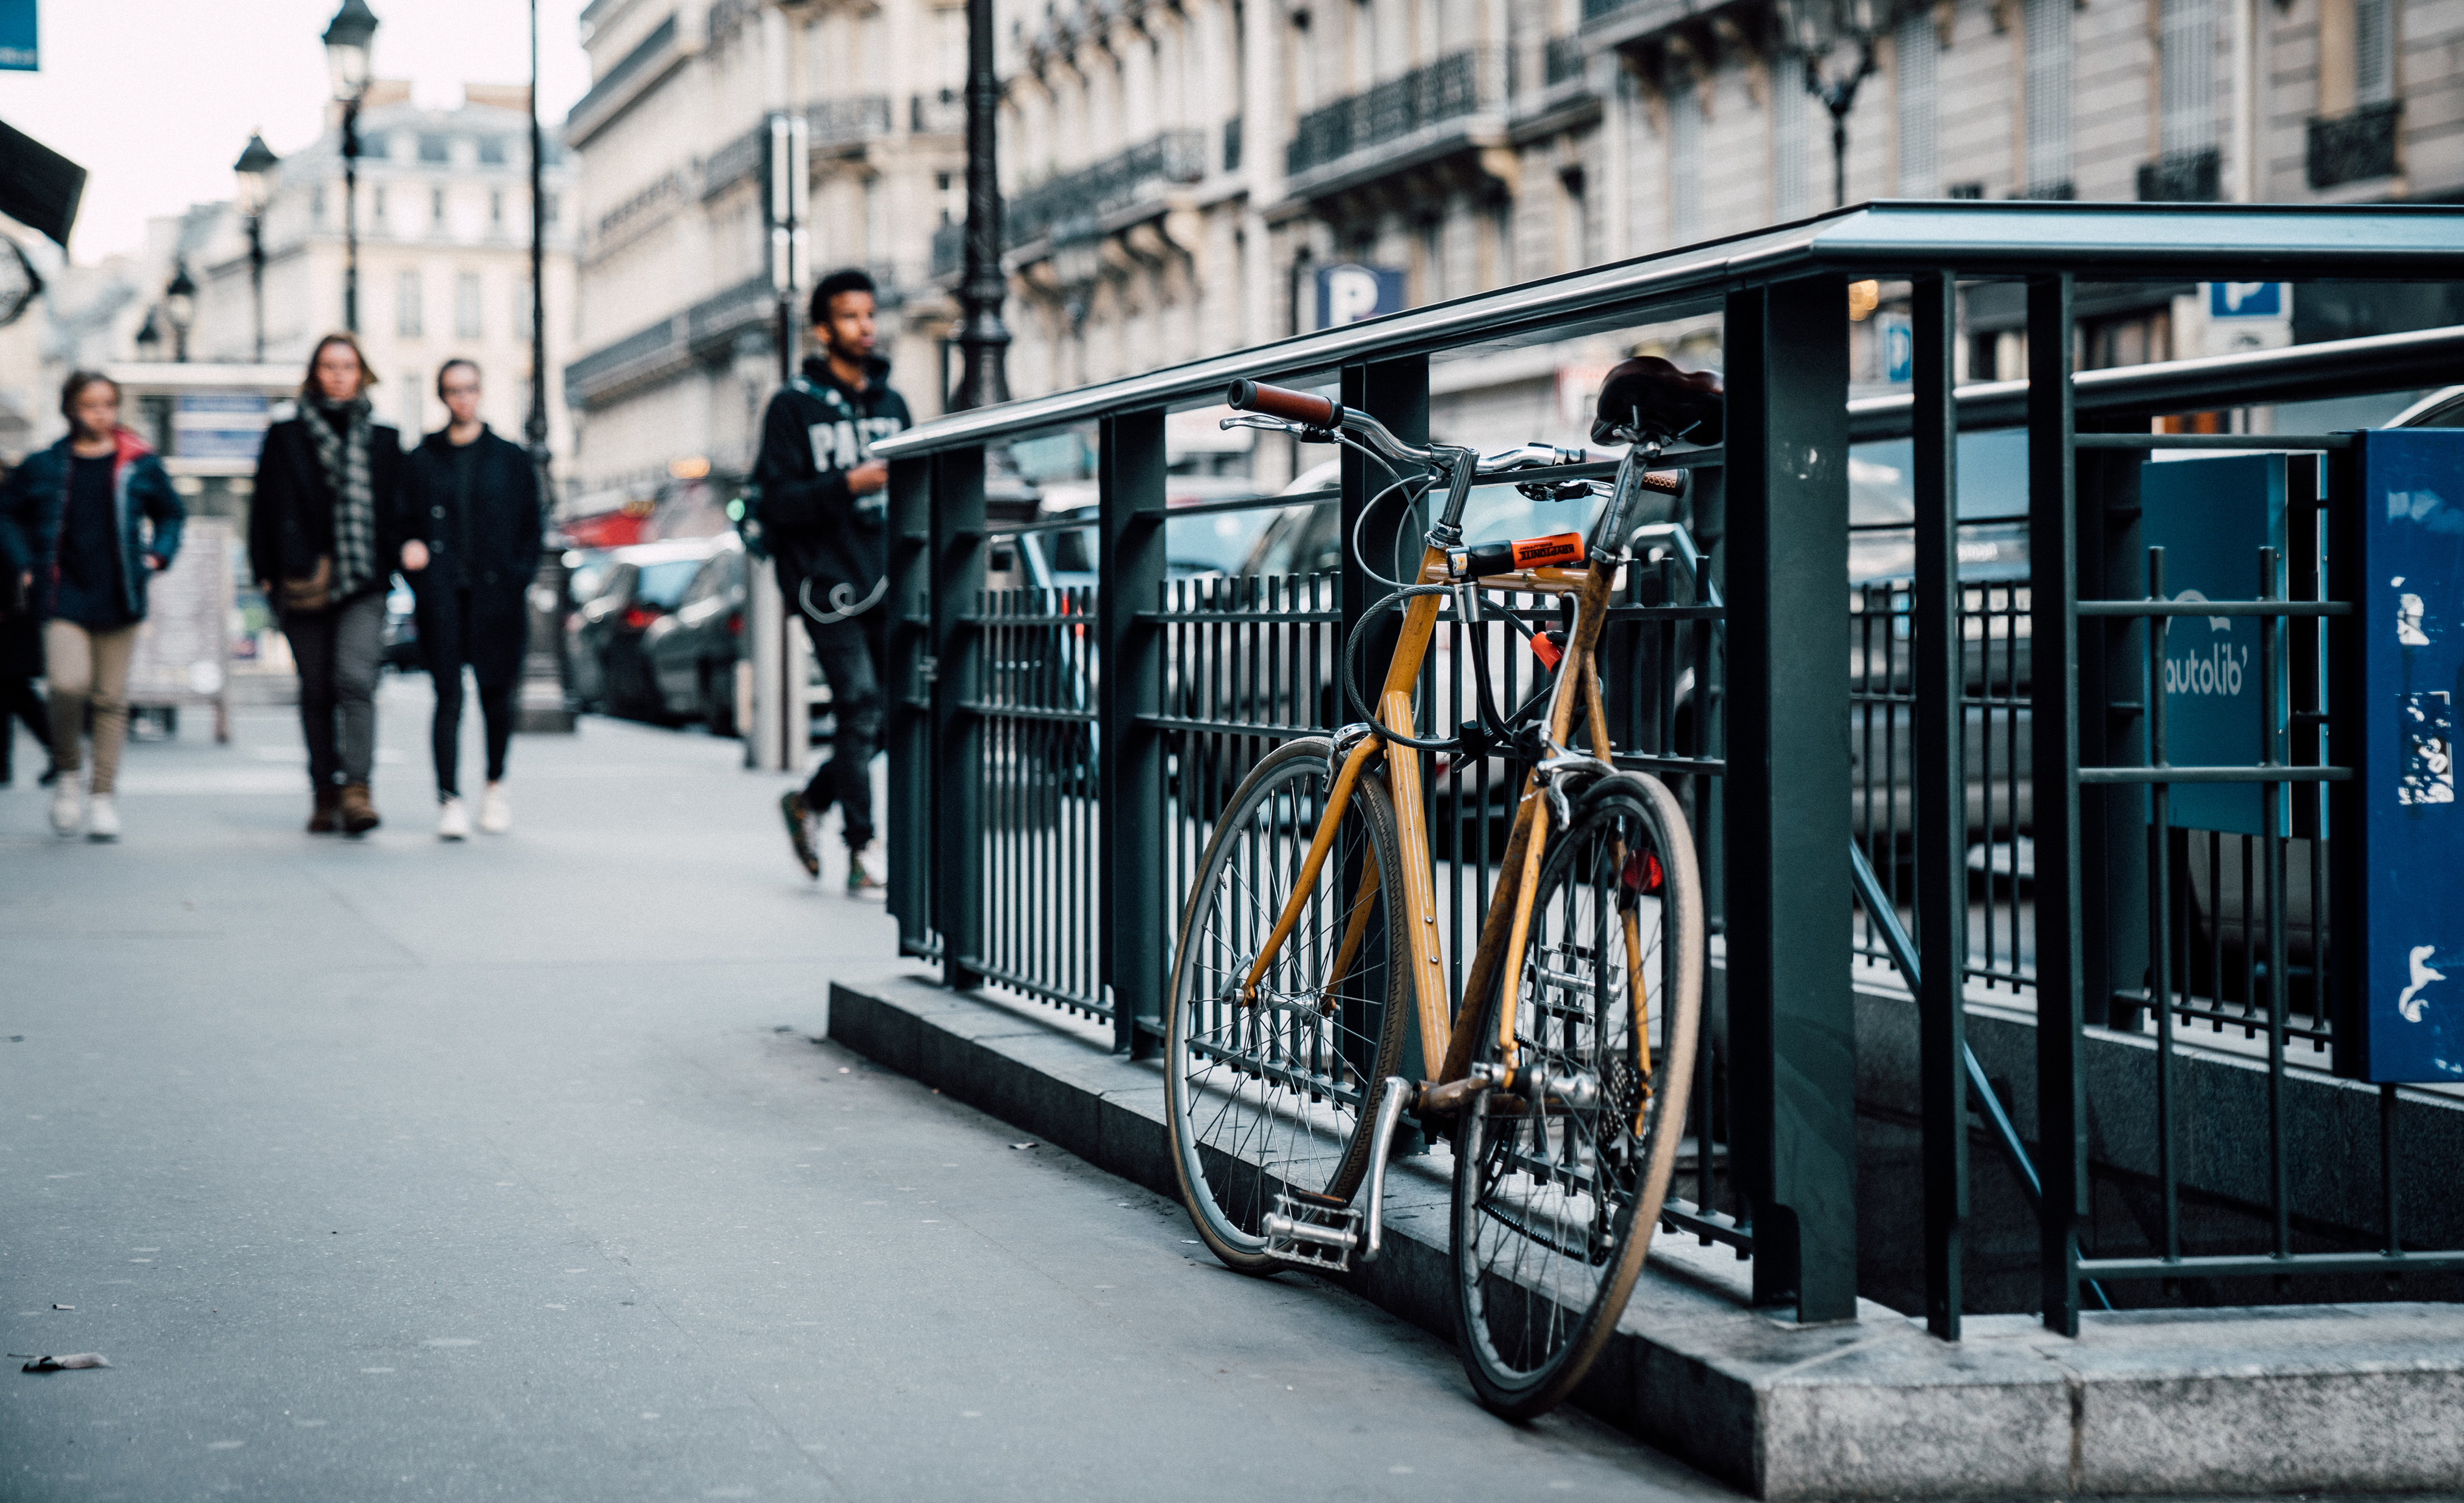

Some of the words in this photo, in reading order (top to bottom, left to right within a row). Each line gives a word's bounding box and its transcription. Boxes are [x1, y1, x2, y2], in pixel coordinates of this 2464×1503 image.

[1328, 270, 1379, 328] P
[1519, 544, 1575, 561] KRYPTONITE
[2166, 641, 2248, 696] autolib'
